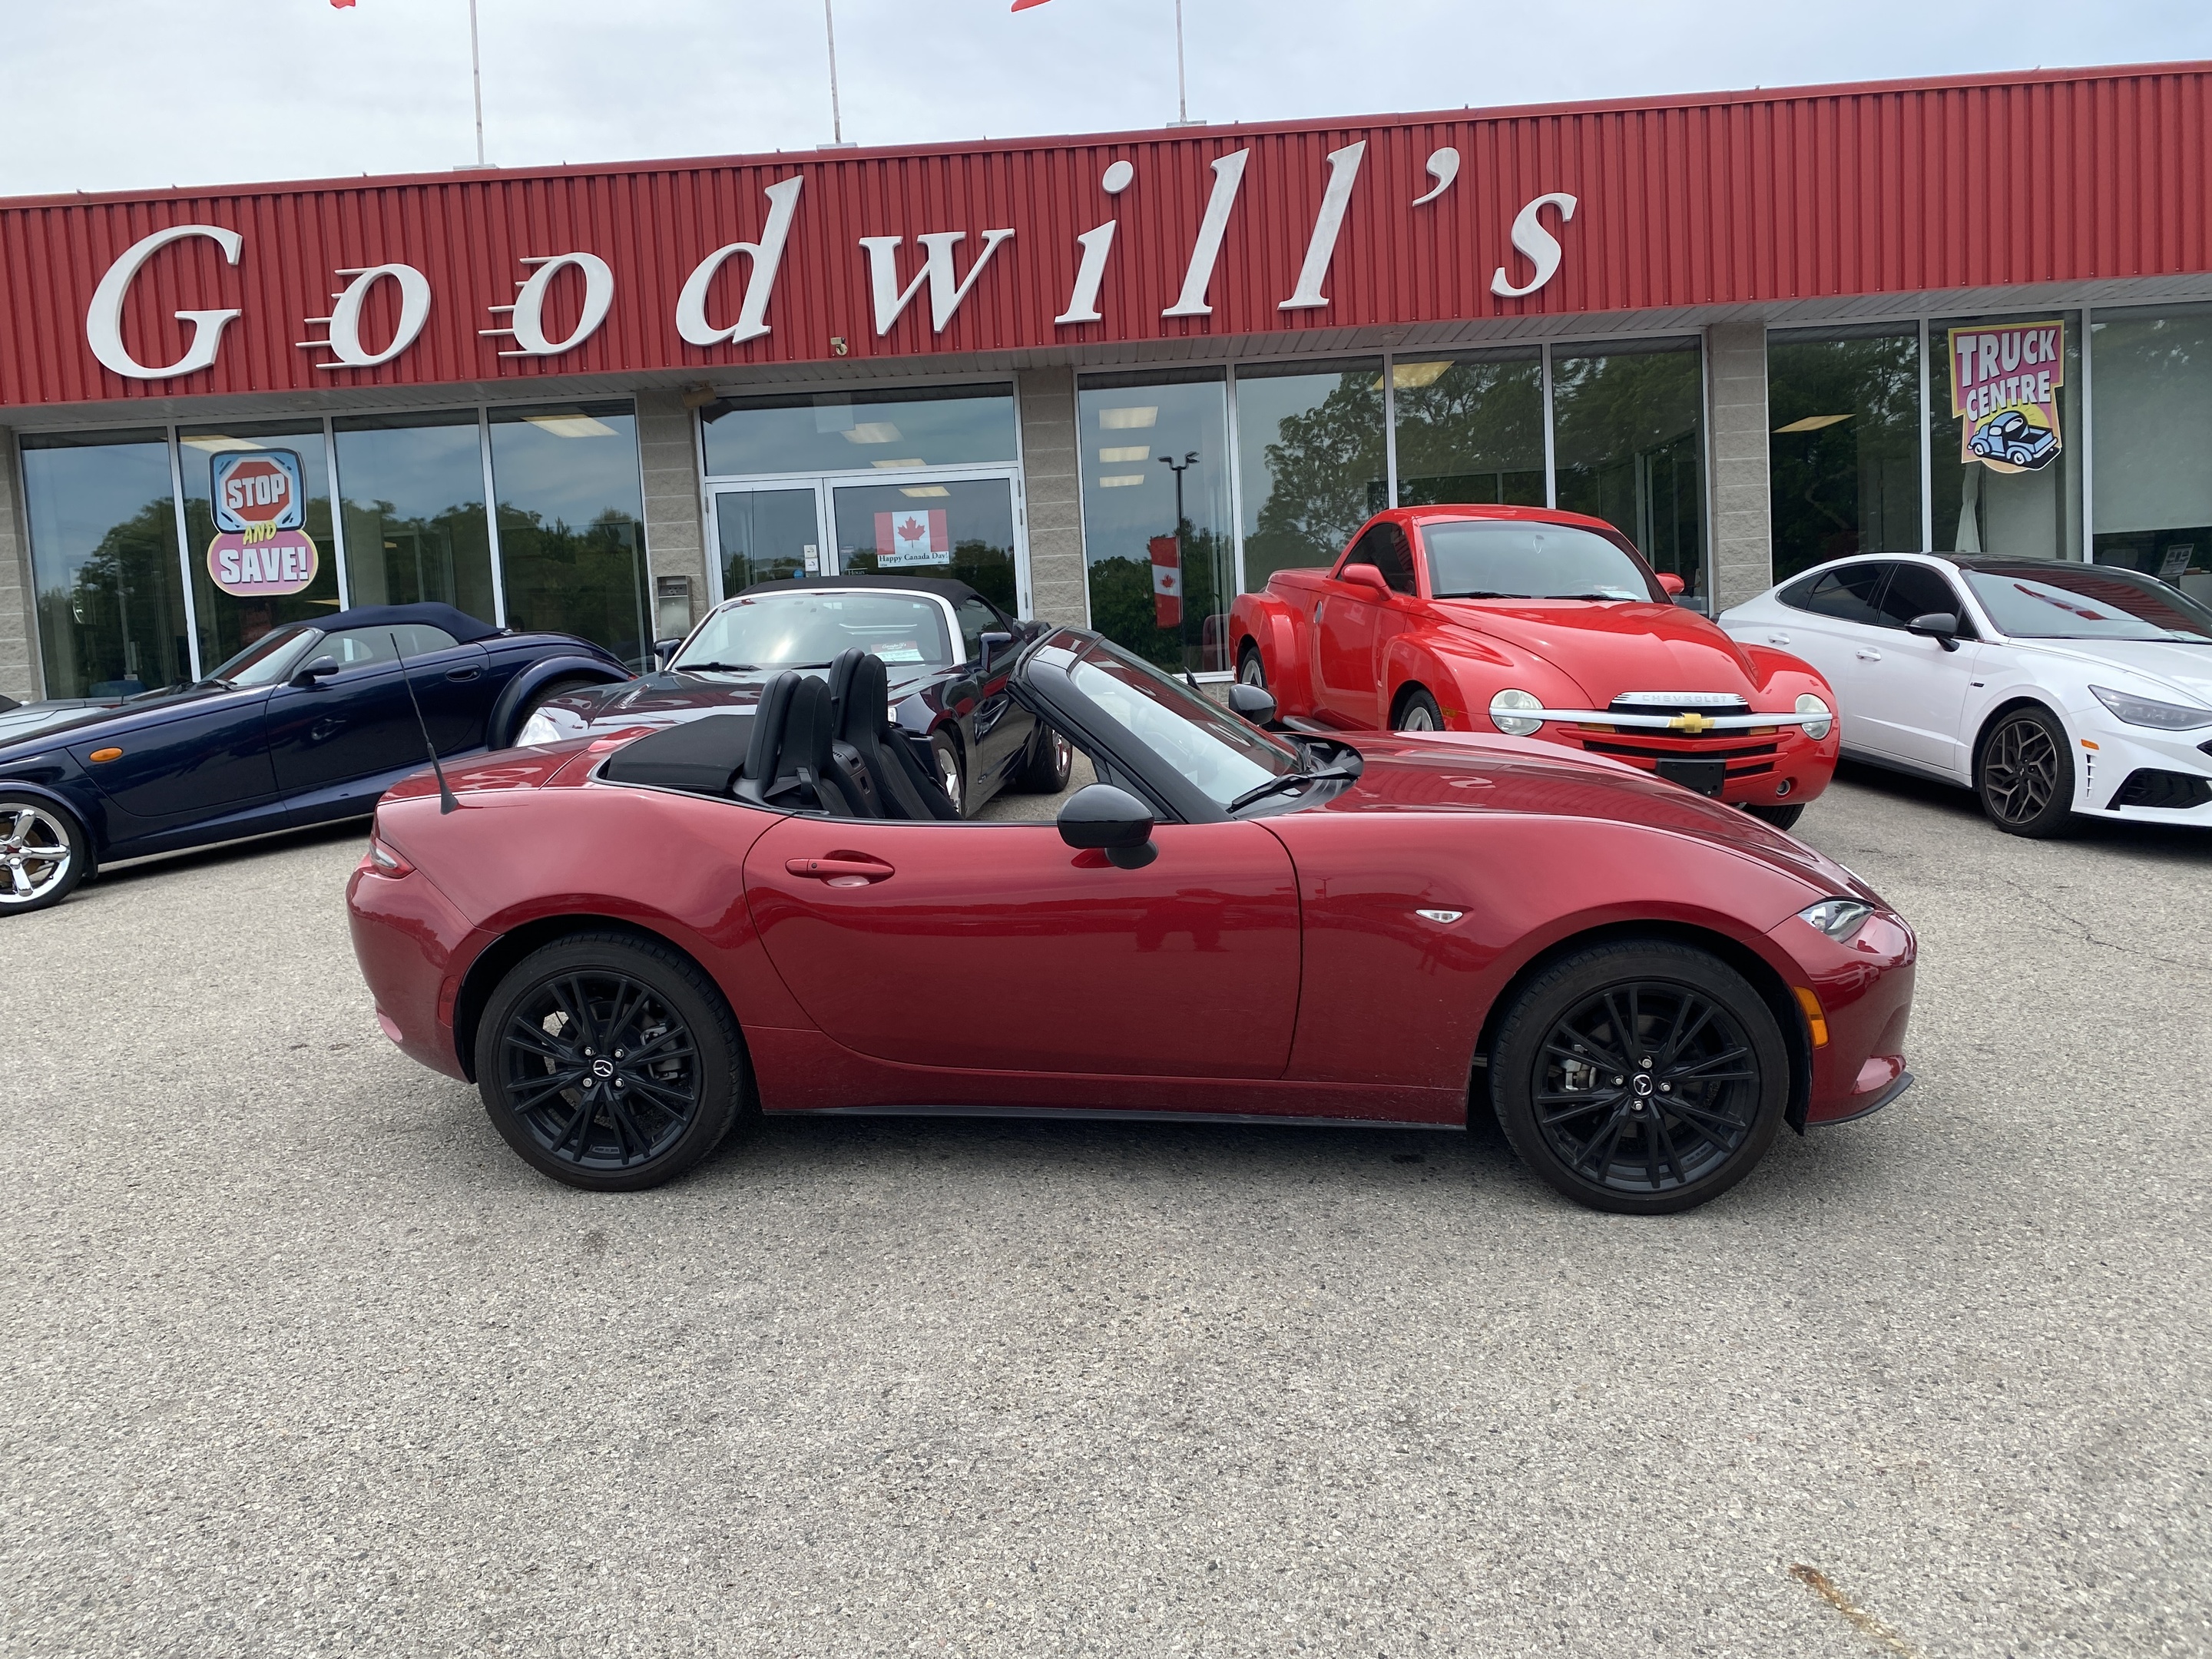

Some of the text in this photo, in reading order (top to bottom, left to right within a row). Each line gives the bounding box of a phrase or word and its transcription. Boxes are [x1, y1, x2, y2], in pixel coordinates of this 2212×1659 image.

[85, 139, 1578, 381] Goodwill's
[1957, 329, 2057, 387] TRUCK
[1966, 369, 2051, 422] CENTRE
[227, 473, 285, 509] STOP
[243, 521, 276, 545] AND
[219, 546, 309, 584] SAVE!
[879, 555, 902, 563] Happy
[904, 552, 930, 561] Canada
[1642, 694, 1727, 703] CHEVROLET
